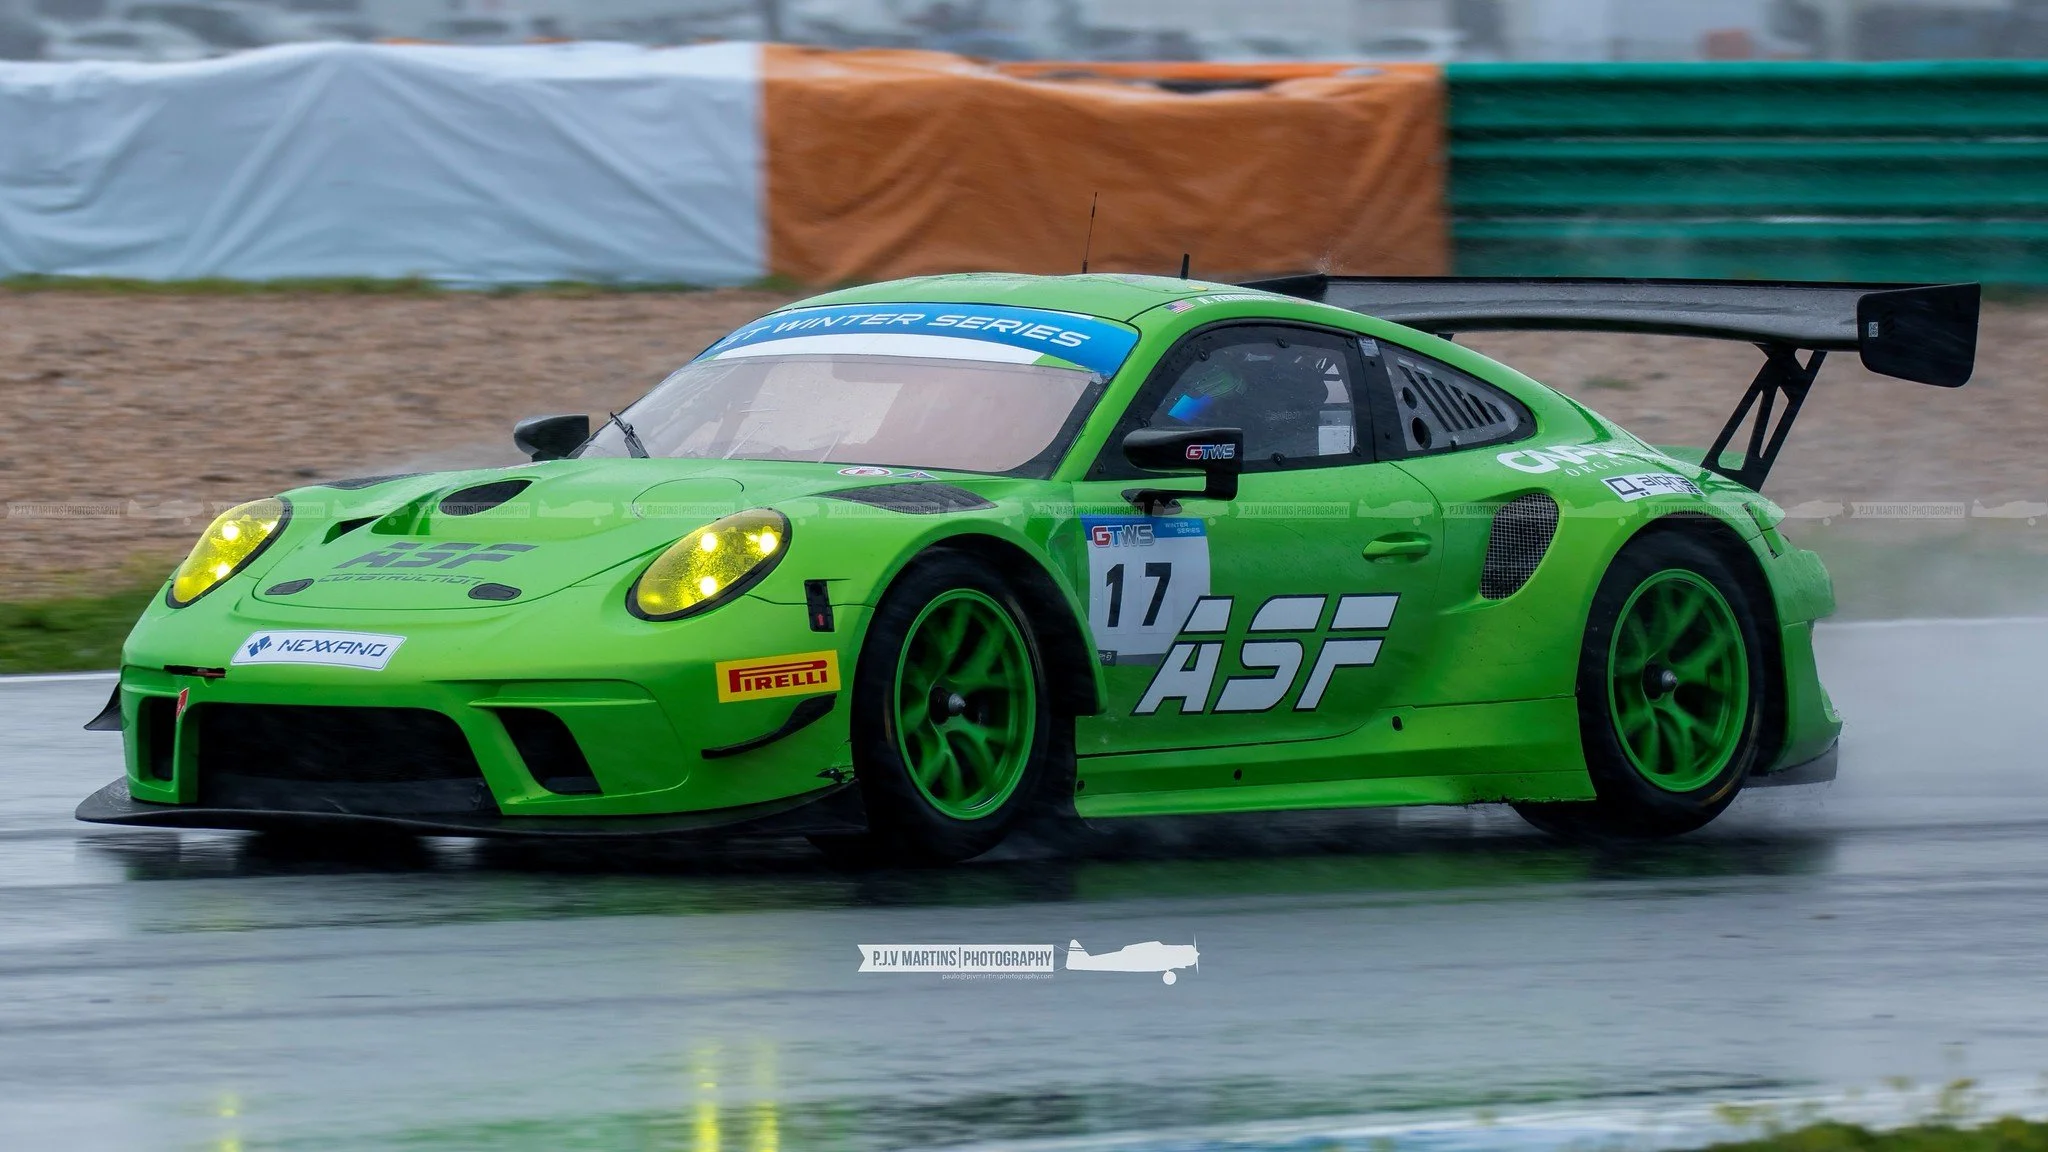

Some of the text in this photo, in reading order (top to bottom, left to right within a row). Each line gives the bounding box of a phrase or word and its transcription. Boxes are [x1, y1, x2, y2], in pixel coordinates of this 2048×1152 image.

[772, 313, 926, 334] WINTER
[926, 313, 1092, 348] SERIES
[1185, 443, 1236, 460] GTWS
[1092, 524, 1155, 547] GTWS
[1164, 521, 1189, 529] WINTER
[1176, 527, 1201, 535] SERIES
[331, 541, 539, 570] ASF
[317, 572, 486, 586] CONSTRUCTION
[1106, 562, 1172, 628] 17
[1131, 593, 1401, 716] ASF
[728, 659, 828, 693] PIRELLI
